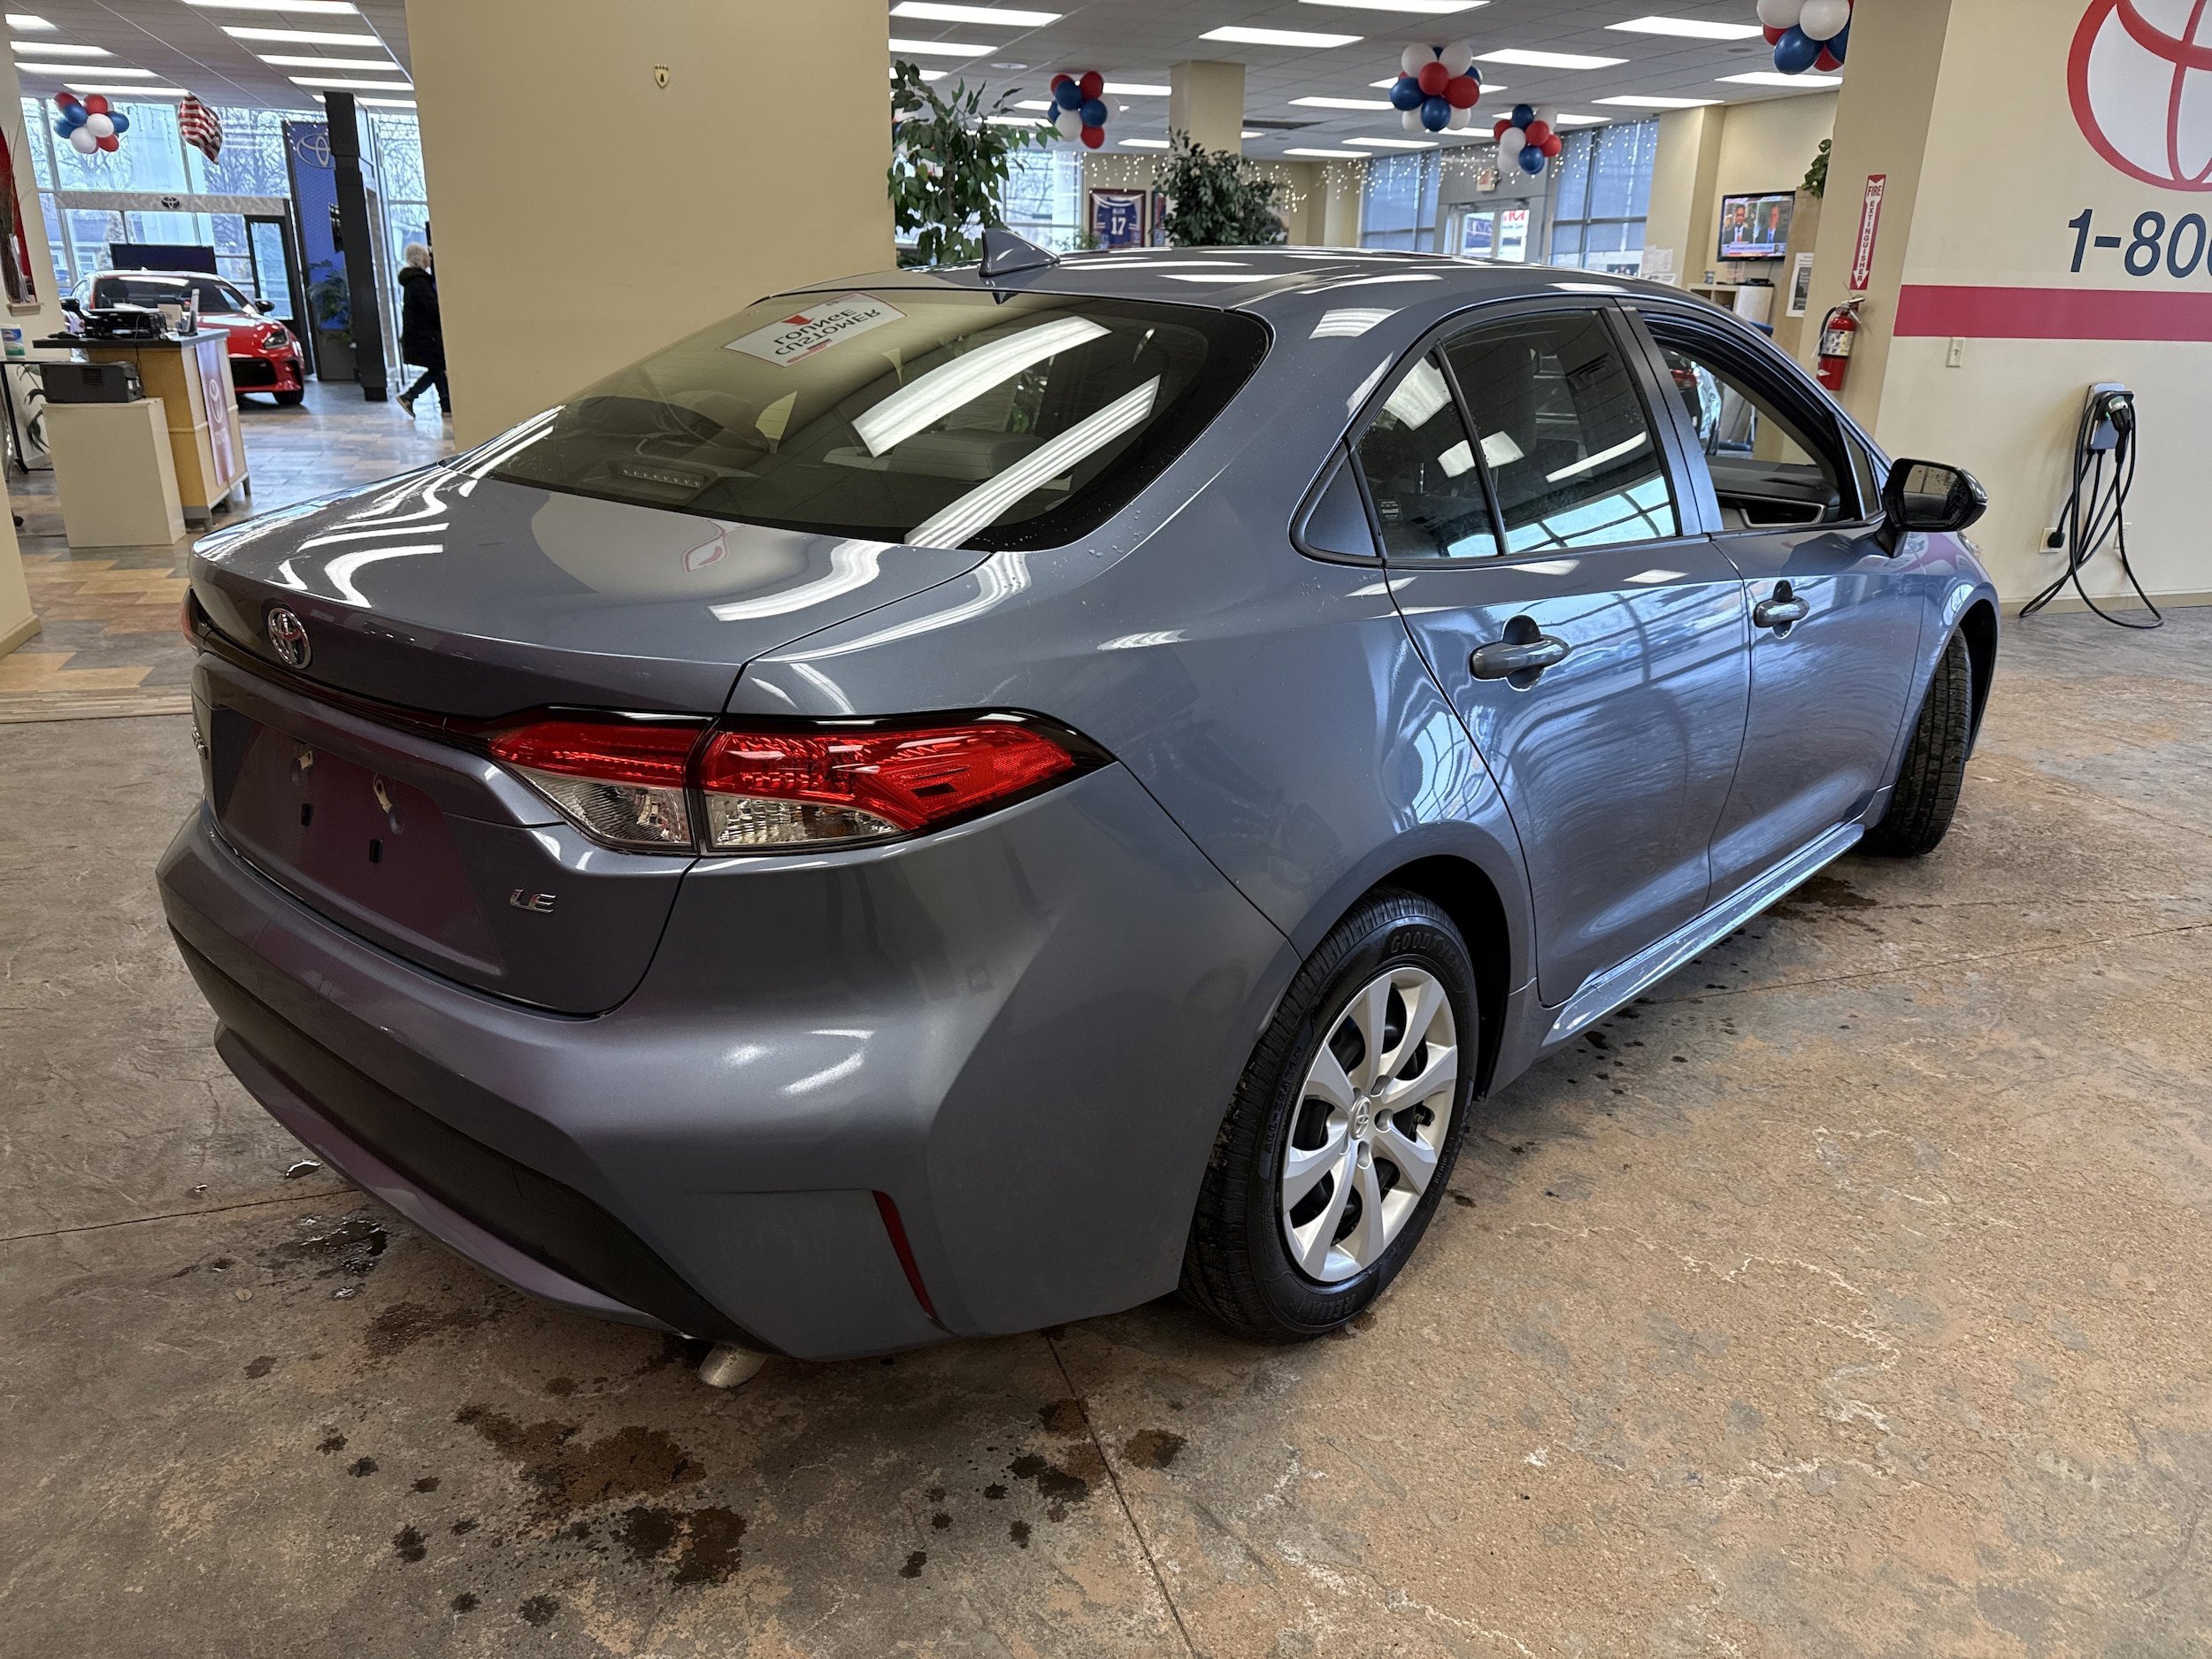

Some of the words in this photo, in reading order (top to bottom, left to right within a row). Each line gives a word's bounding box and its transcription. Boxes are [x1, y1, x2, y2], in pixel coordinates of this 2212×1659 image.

[1867, 185, 1882, 197] FIRE
[1111, 217, 1126, 234] 17
[1857, 200, 1876, 282] EXTINGUISHER
[2068, 208, 2212, 279] 1-80
[510, 888, 557, 914] LE
